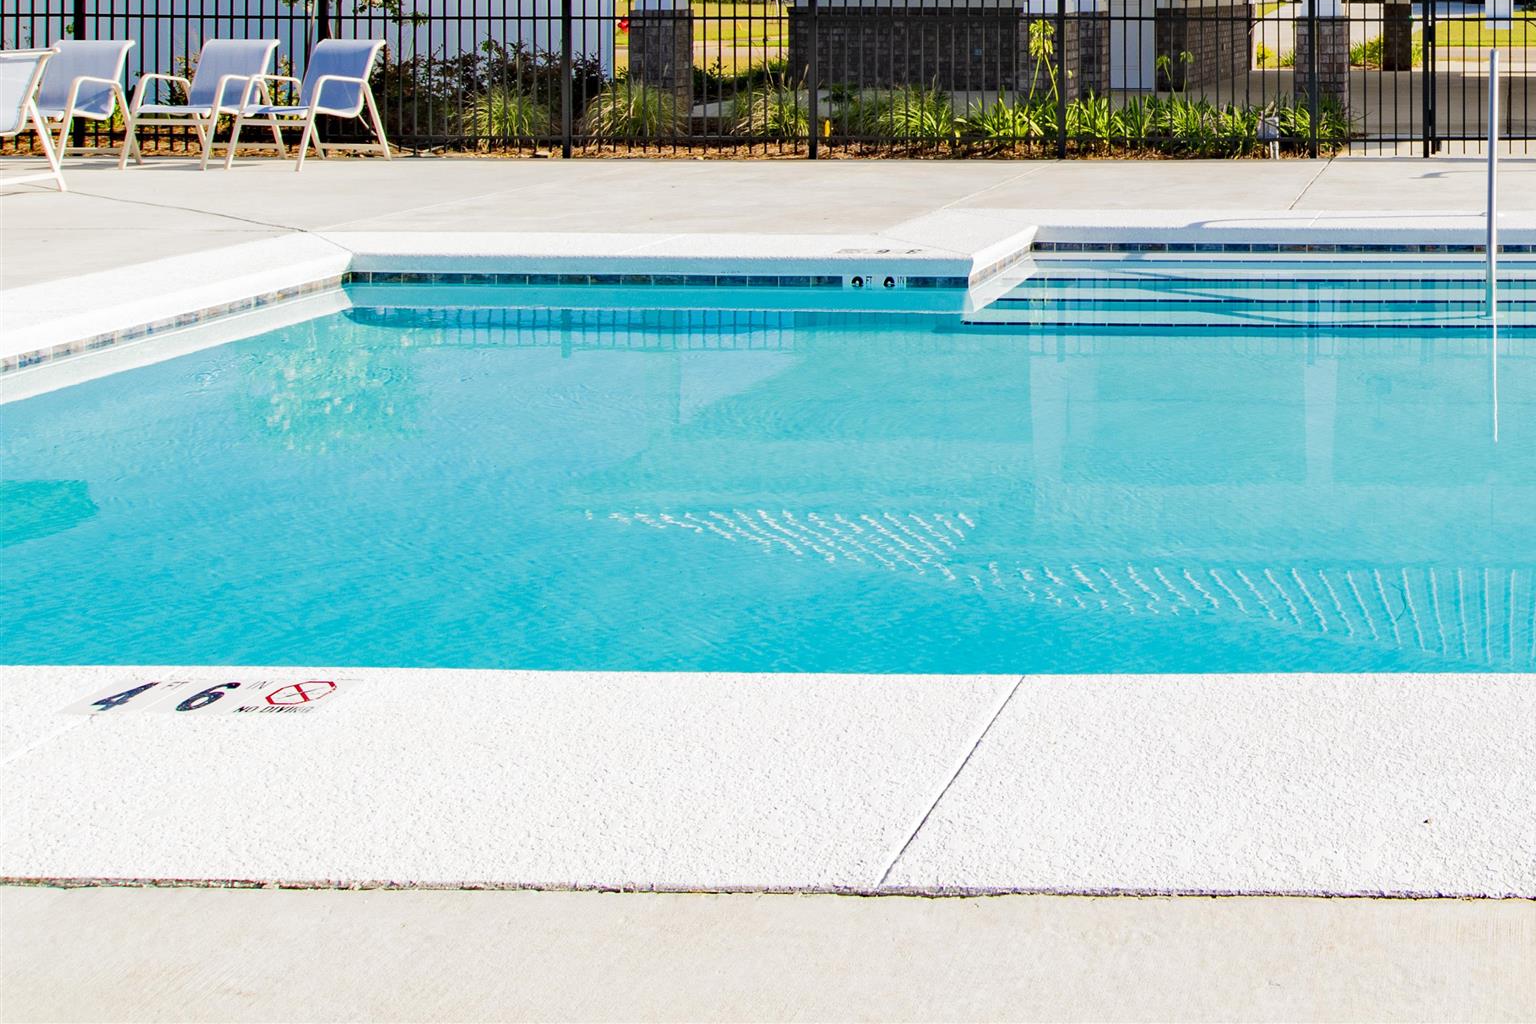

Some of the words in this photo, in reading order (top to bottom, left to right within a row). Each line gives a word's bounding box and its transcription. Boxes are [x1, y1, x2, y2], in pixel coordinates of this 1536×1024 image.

[90, 681, 160, 712] 4
[175, 681, 241, 713] 6
[233, 705, 260, 714] NO
